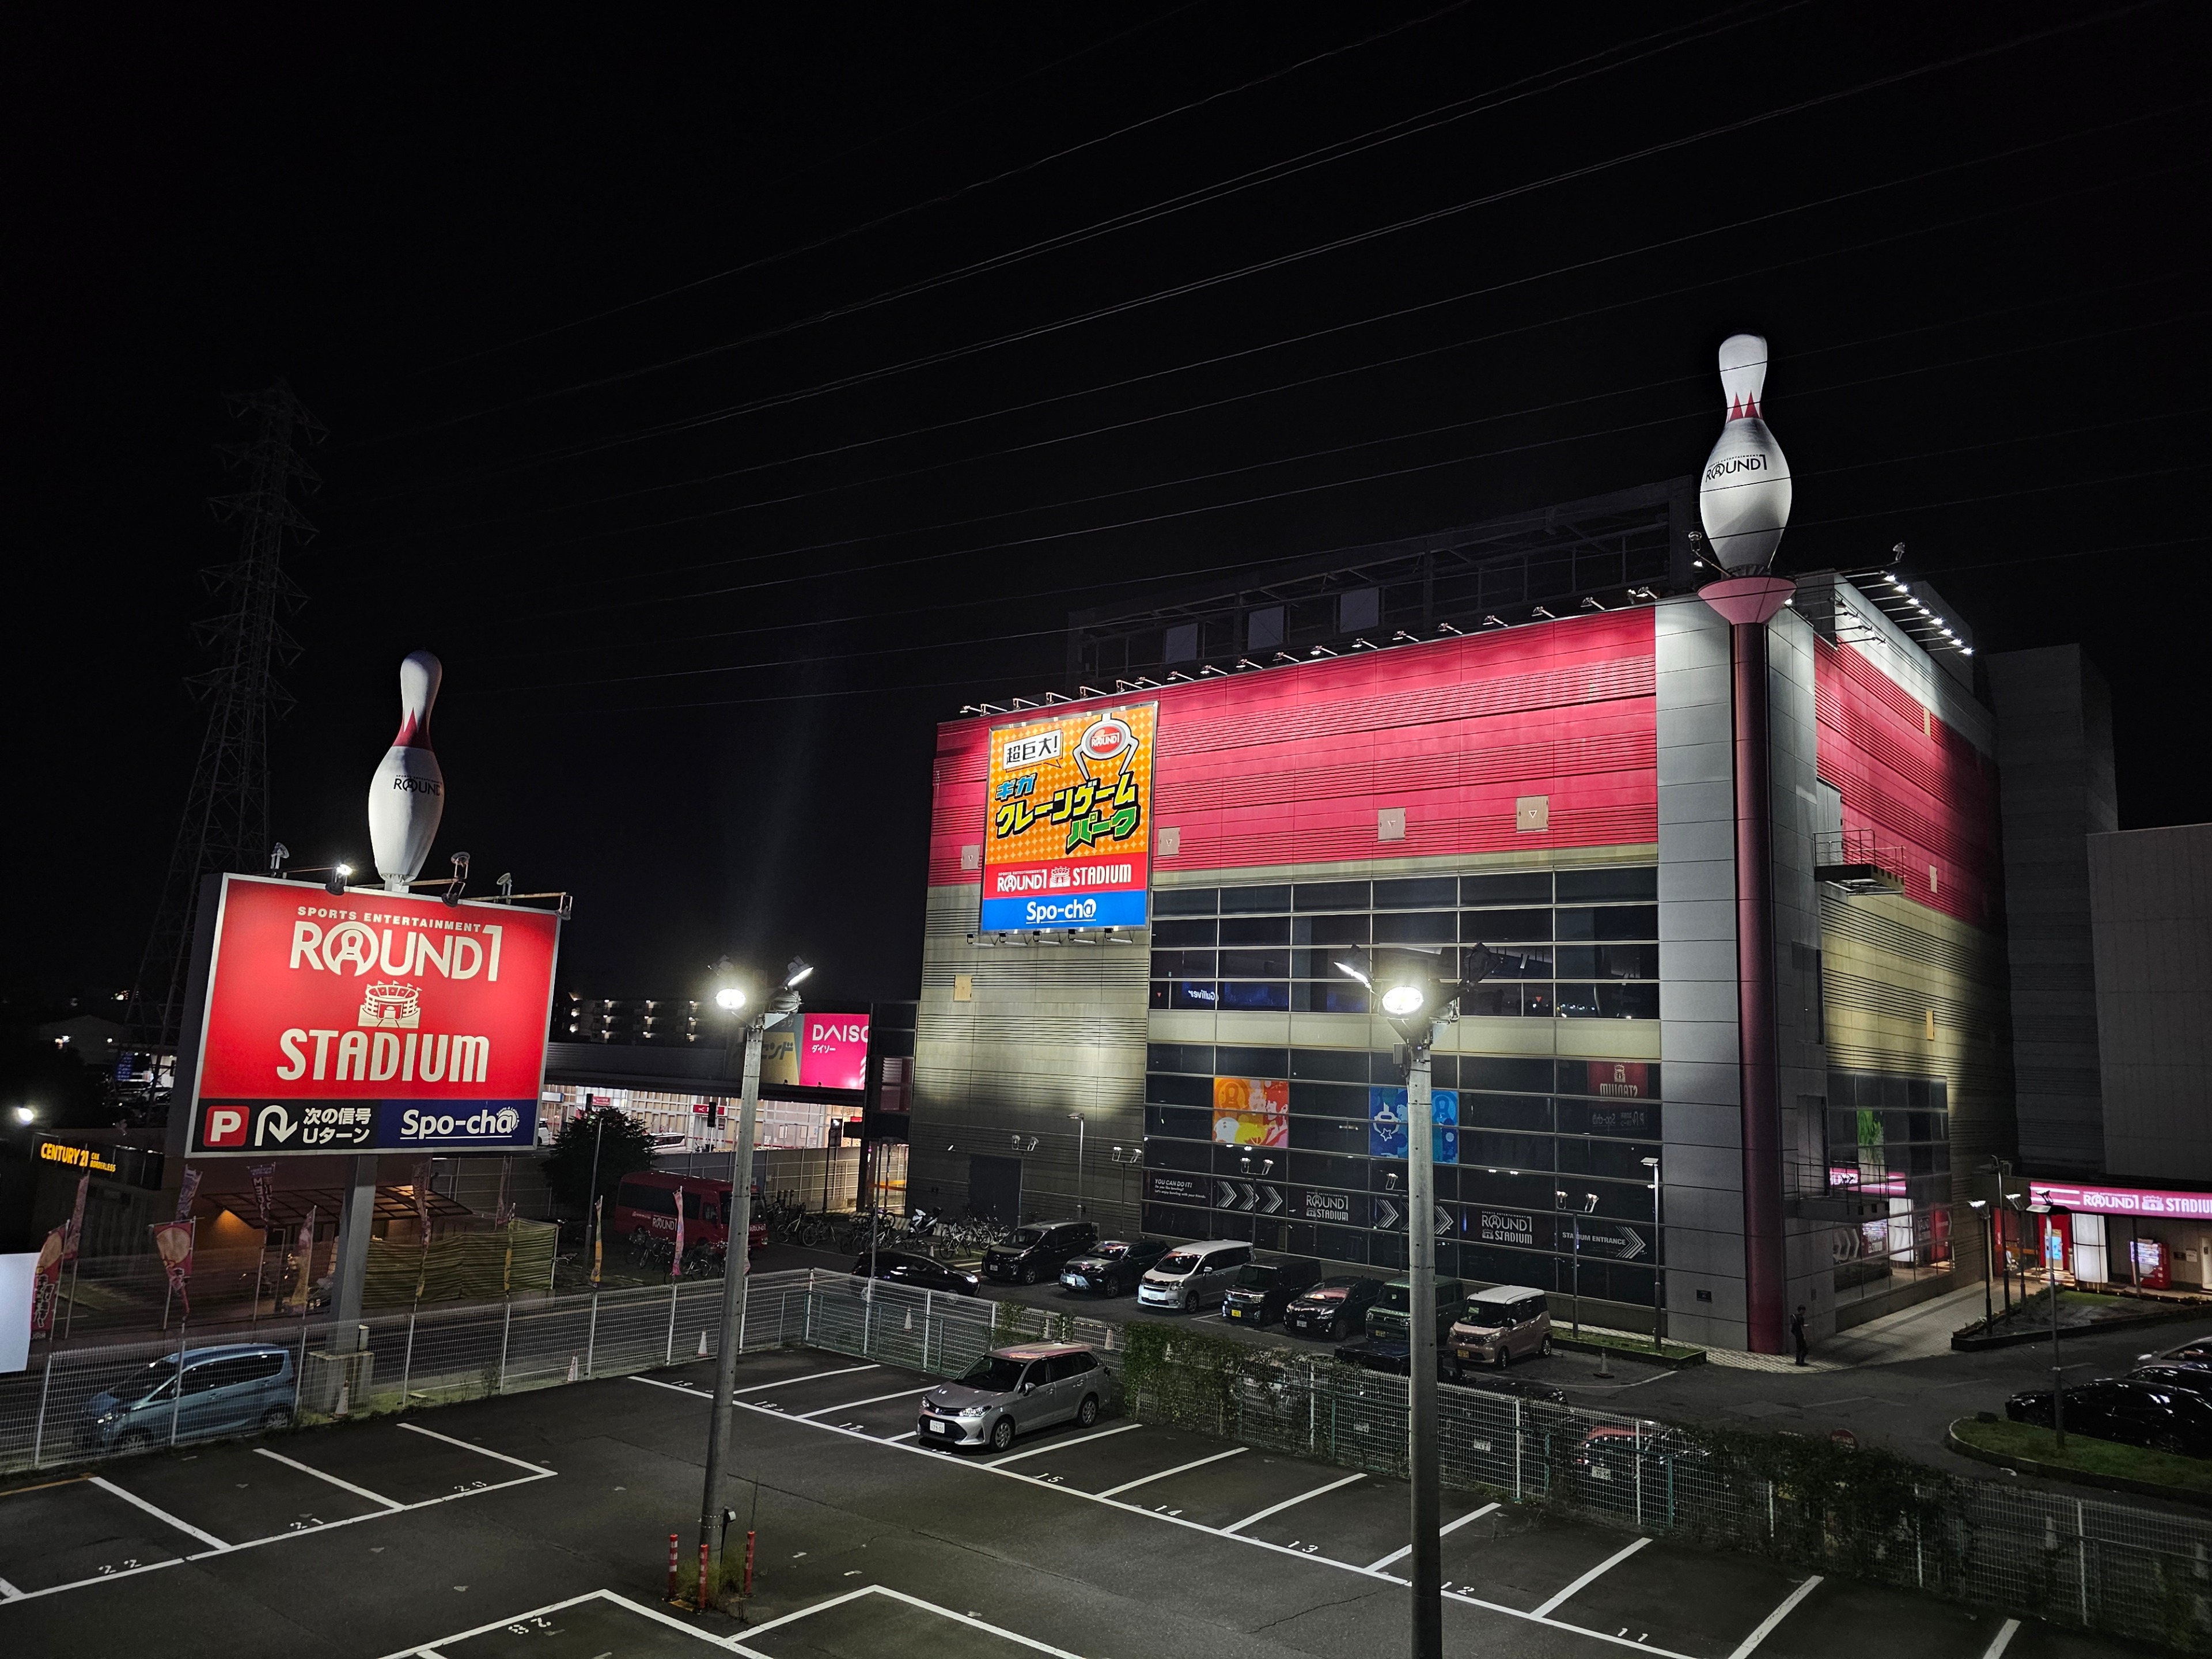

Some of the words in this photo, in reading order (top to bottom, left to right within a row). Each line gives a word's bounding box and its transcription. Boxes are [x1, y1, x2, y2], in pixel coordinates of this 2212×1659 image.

[1705, 454, 1767, 483] ROUND1
[1091, 732, 1120, 747] ROUND1
[1006, 734, 1058, 766] 超巨大!
[995, 773, 1037, 800] ギガ
[995, 772, 1138, 838] クレーンゲーム
[1066, 806, 1138, 851] パーク
[997, 869, 1047, 892] ROUND1
[1073, 863, 1131, 886] STADIUM
[1027, 899, 1097, 923] Spo-cha
[297, 906, 358, 921] SPORTS
[363, 912, 481, 933] ENTERTAINMENT
[289, 921, 502, 982] ROUND1
[276, 1028, 490, 1083] STADIUM
[811, 1044, 836, 1054] ダイソー
[303, 1107, 372, 1125] 次の信号
[401, 1108, 516, 1139] Spo-cha
[210, 1111, 241, 1142] P
[302, 1127, 370, 1143] Uターン
[40, 1142, 81, 1165] CENTURY
[79, 1150, 89, 1167] 21
[1306, 1194, 1349, 1210] ROUND1
[2083, 1194, 2139, 1210] ROUND1
[1316, 1209, 1349, 1221] STADIUM
[652, 1217, 677, 1232] ROUND1
[1482, 1214, 1532, 1233] ROUND1
[1495, 1230, 1532, 1244] STADIUM
[1592, 1235, 1626, 1245] ENTRANCE
[1036, 1473, 1064, 1483] 15
[453, 1481, 487, 1492] 20
[1154, 1505, 1183, 1516] 14
[290, 1518, 324, 1530] 21
[1288, 1540, 1319, 1553] 13
[99, 1559, 142, 1574] 22
[1440, 1581, 1475, 1595] 12
[1618, 1627, 1649, 1642] 11
